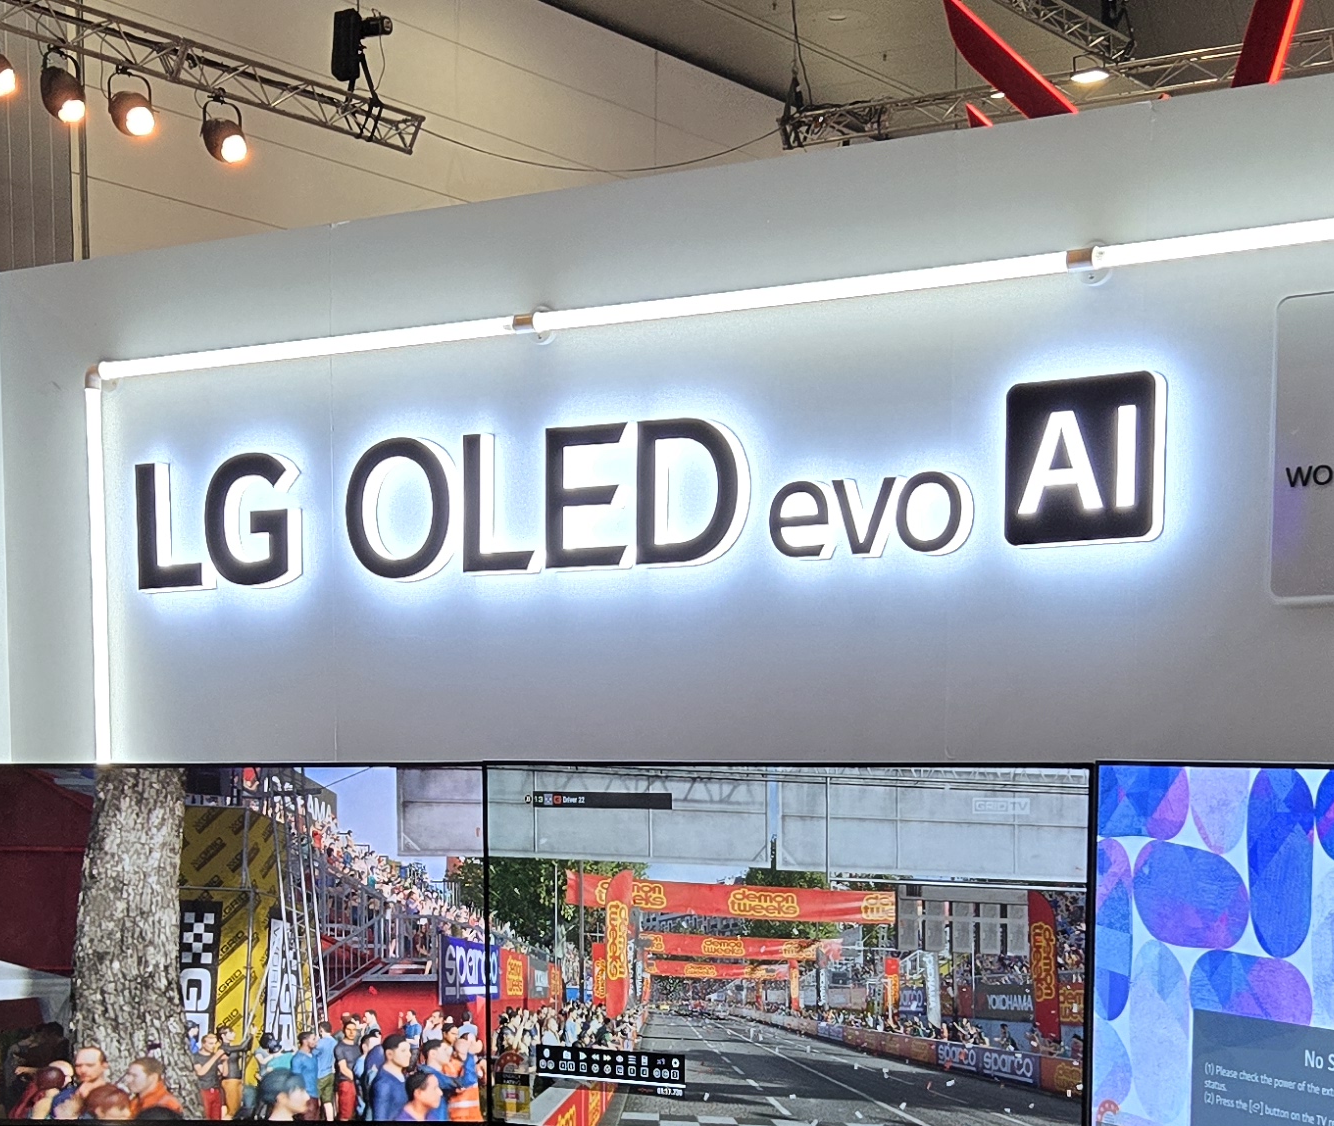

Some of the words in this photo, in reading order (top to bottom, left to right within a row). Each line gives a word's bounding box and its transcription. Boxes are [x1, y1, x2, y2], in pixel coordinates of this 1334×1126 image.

[134, 452, 300, 592] LG
[345, 417, 751, 582] OLED
[769, 470, 974, 561] evo
[1010, 392, 1149, 530] AI
[1010, 801, 1028, 811] TV
[732, 889, 795, 904] demon
[731, 902, 798, 916] tweeks
[987, 994, 1034, 1011] YOKOHAMA
[938, 1045, 977, 1067] sparco
[983, 1051, 1034, 1077] sparco
[1304, 1050, 1324, 1068] No
[1204, 1062, 1214, 1075] (1)
[1216, 1065, 1238, 1079] Please
[1239, 1070, 1259, 1083] check
[1260, 1074, 1273, 1085] the
[1273, 1078, 1297, 1090] power
[1297, 1080, 1307, 1092] of
[1307, 1083, 1320, 1095] the
[1204, 1079, 1227, 1092] status.
[1204, 1091, 1214, 1105] (2)
[1215, 1095, 1235, 1108] Press
[1236, 1099, 1248, 1111] the
[1264, 1105, 1289, 1119] button
[1290, 1111, 1300, 1122] on
[1302, 1112, 1314, 1125] the
[1316, 1114, 1328, 1126] TV
